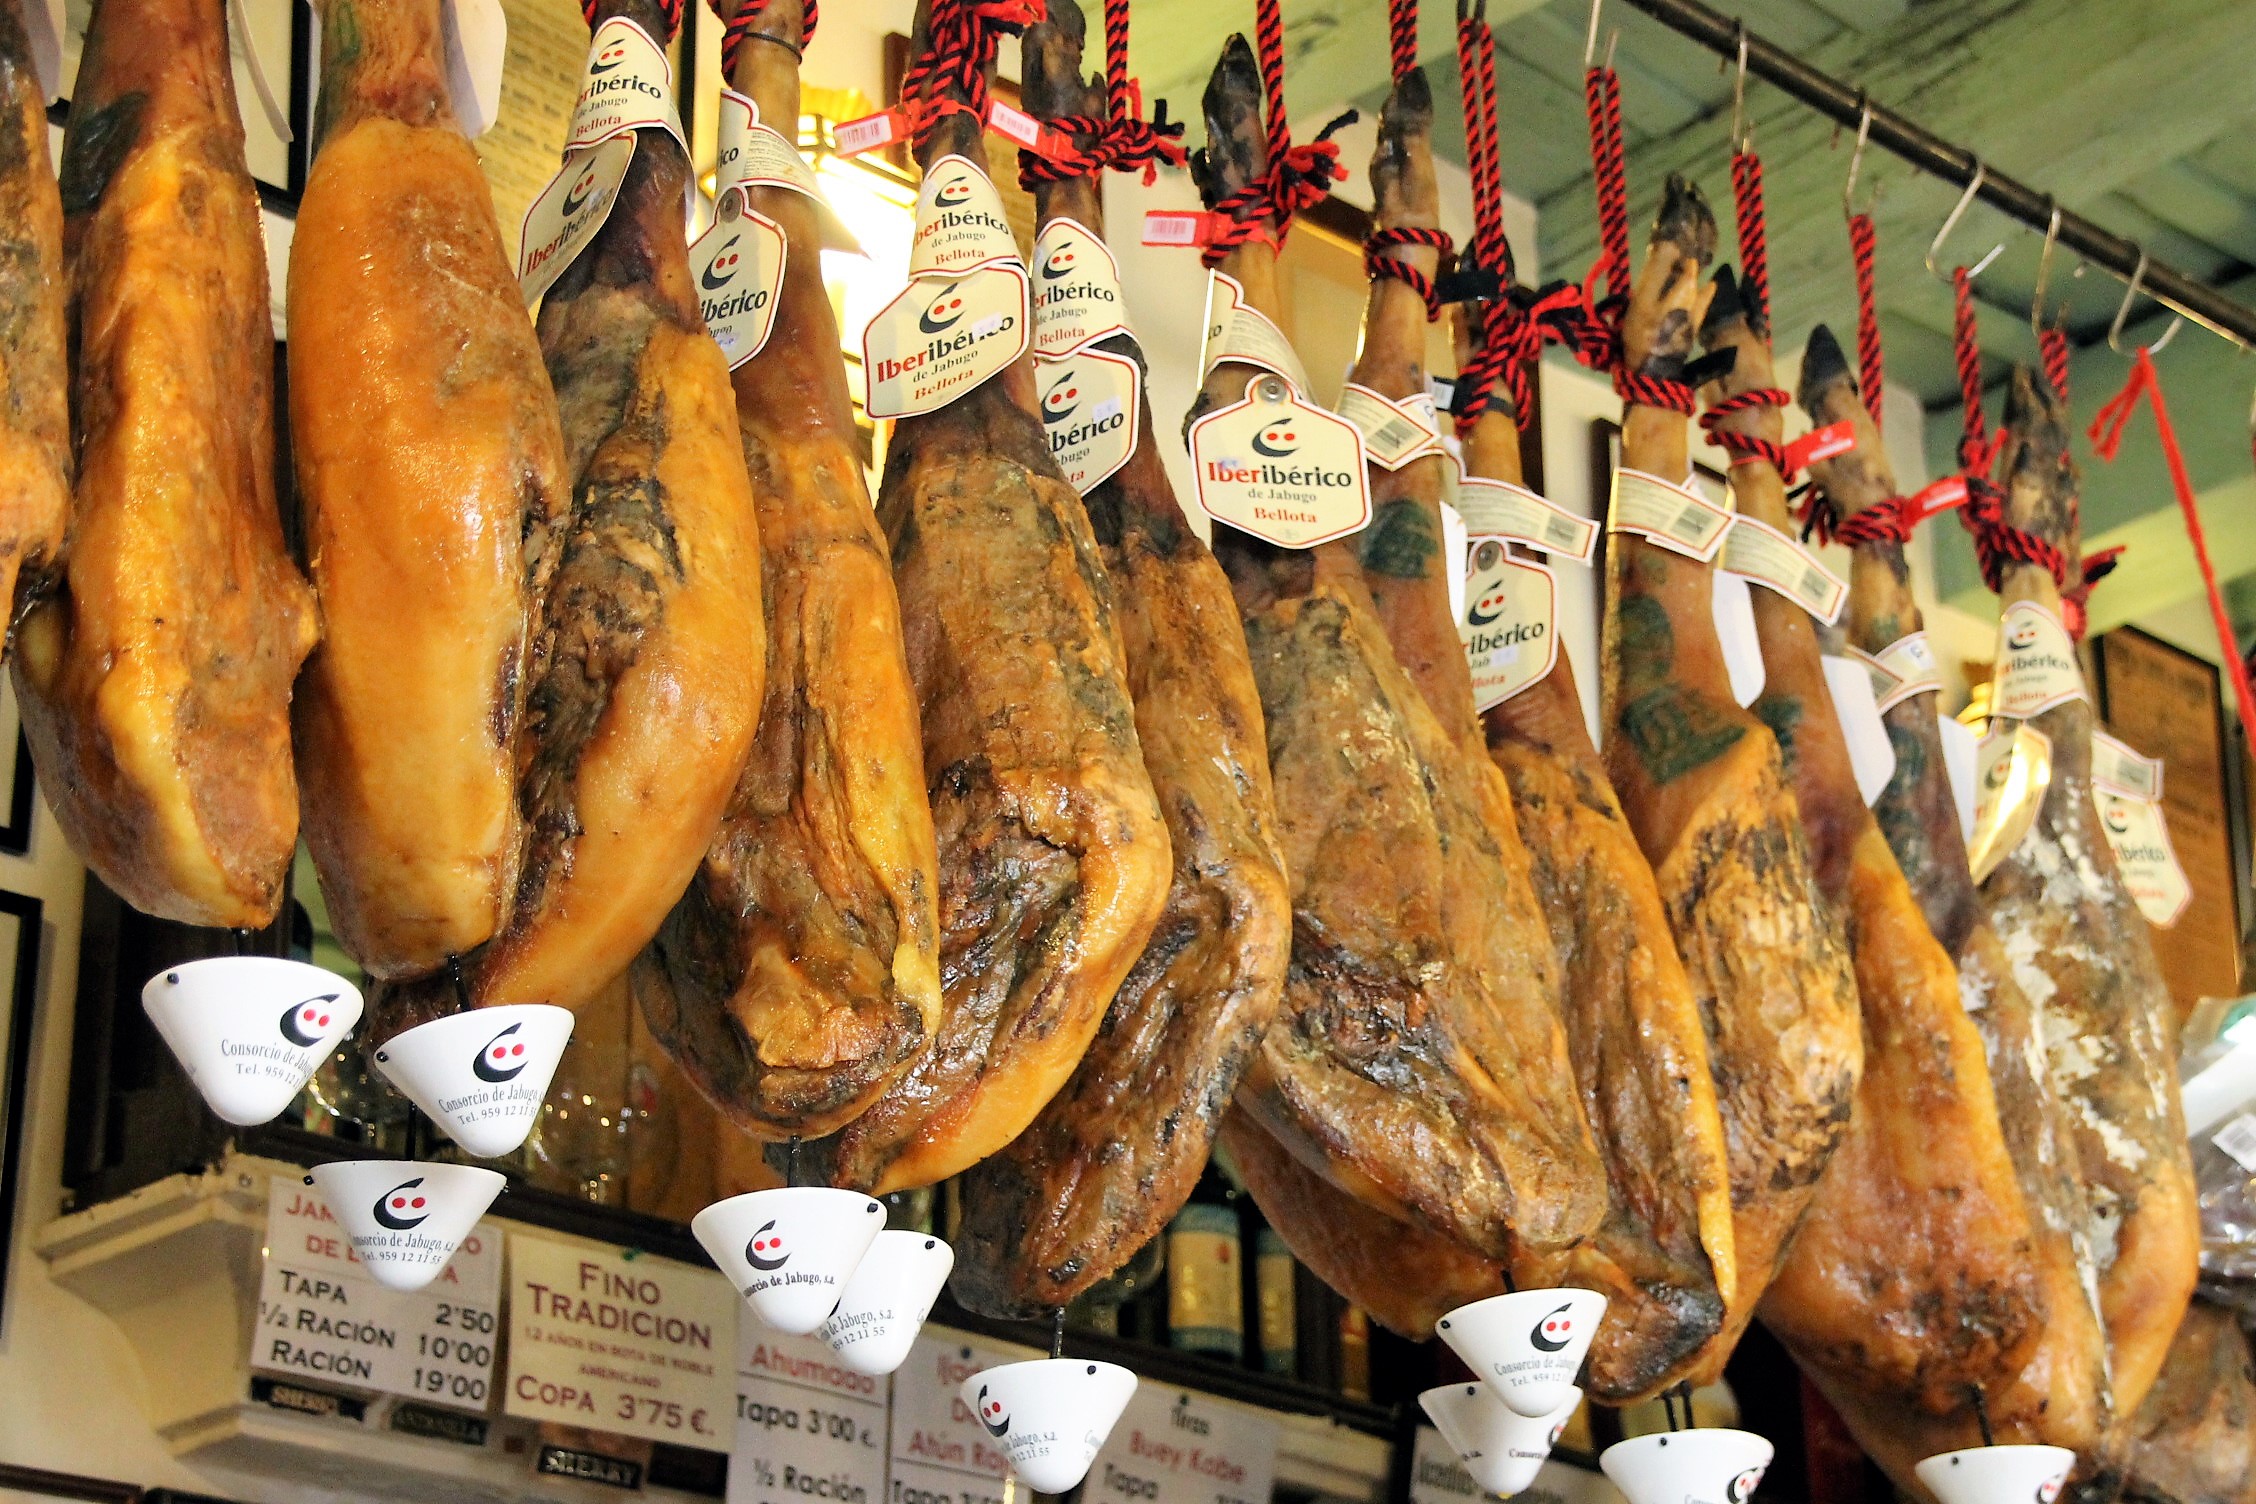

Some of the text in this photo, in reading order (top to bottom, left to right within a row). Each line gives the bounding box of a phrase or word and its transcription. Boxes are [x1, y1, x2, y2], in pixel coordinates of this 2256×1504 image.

[589, 97, 628, 114] Jabugo
[576, 115, 622, 139] Bellota
[931, 232, 986, 249] de Jabugo
[935, 248, 985, 266] Bellota
[1049, 307, 1087, 321] Jabugo
[1040, 327, 1086, 347] Bellota
[913, 350, 978, 384] de Jabugo
[914, 369, 974, 401] Bellota
[1208, 461, 1352, 488] Iberibérico
[1248, 487, 1317, 504] de Jabugo
[1254, 507, 1318, 524] Bellota
[221, 1038, 281, 1061] Consorcio
[283, 1047, 296, 1066] de
[236, 1063, 260, 1075] Tel.
[265, 1065, 285, 1083] 959
[438, 1088, 489, 1114] Consorcio
[492, 1085, 505, 1102] de
[457, 1112, 479, 1126] Tel.
[481, 1107, 500, 1121] 959
[505, 1105, 516, 1116] 12
[306, 1233, 339, 1259] DE
[390, 1232, 403, 1247] de
[380, 1251, 397, 1262] 959
[401, 1252, 414, 1262] 12
[417, 1254, 429, 1263] 11
[280, 1268, 348, 1305] TAPA
[579, 1261, 661, 1305] FINO
[770, 1273, 782, 1287] de
[785, 1271, 822, 1286] Jabugo,
[527, 1281, 712, 1350] TRADICION
[296, 1308, 397, 1349] RACIÓN
[828, 1321, 839, 1337] de
[843, 1335, 856, 1346] 12
[857, 1329, 869, 1341] 11
[873, 1325, 885, 1337] 55
[271, 1339, 373, 1379] RACIÓN
[1494, 1355, 1542, 1376] Consorcio
[1543, 1354, 1554, 1368] de
[516, 1374, 597, 1414] COPA
[736, 1393, 799, 1431] Tapa
[1104, 1462, 1160, 1501] Tapa
